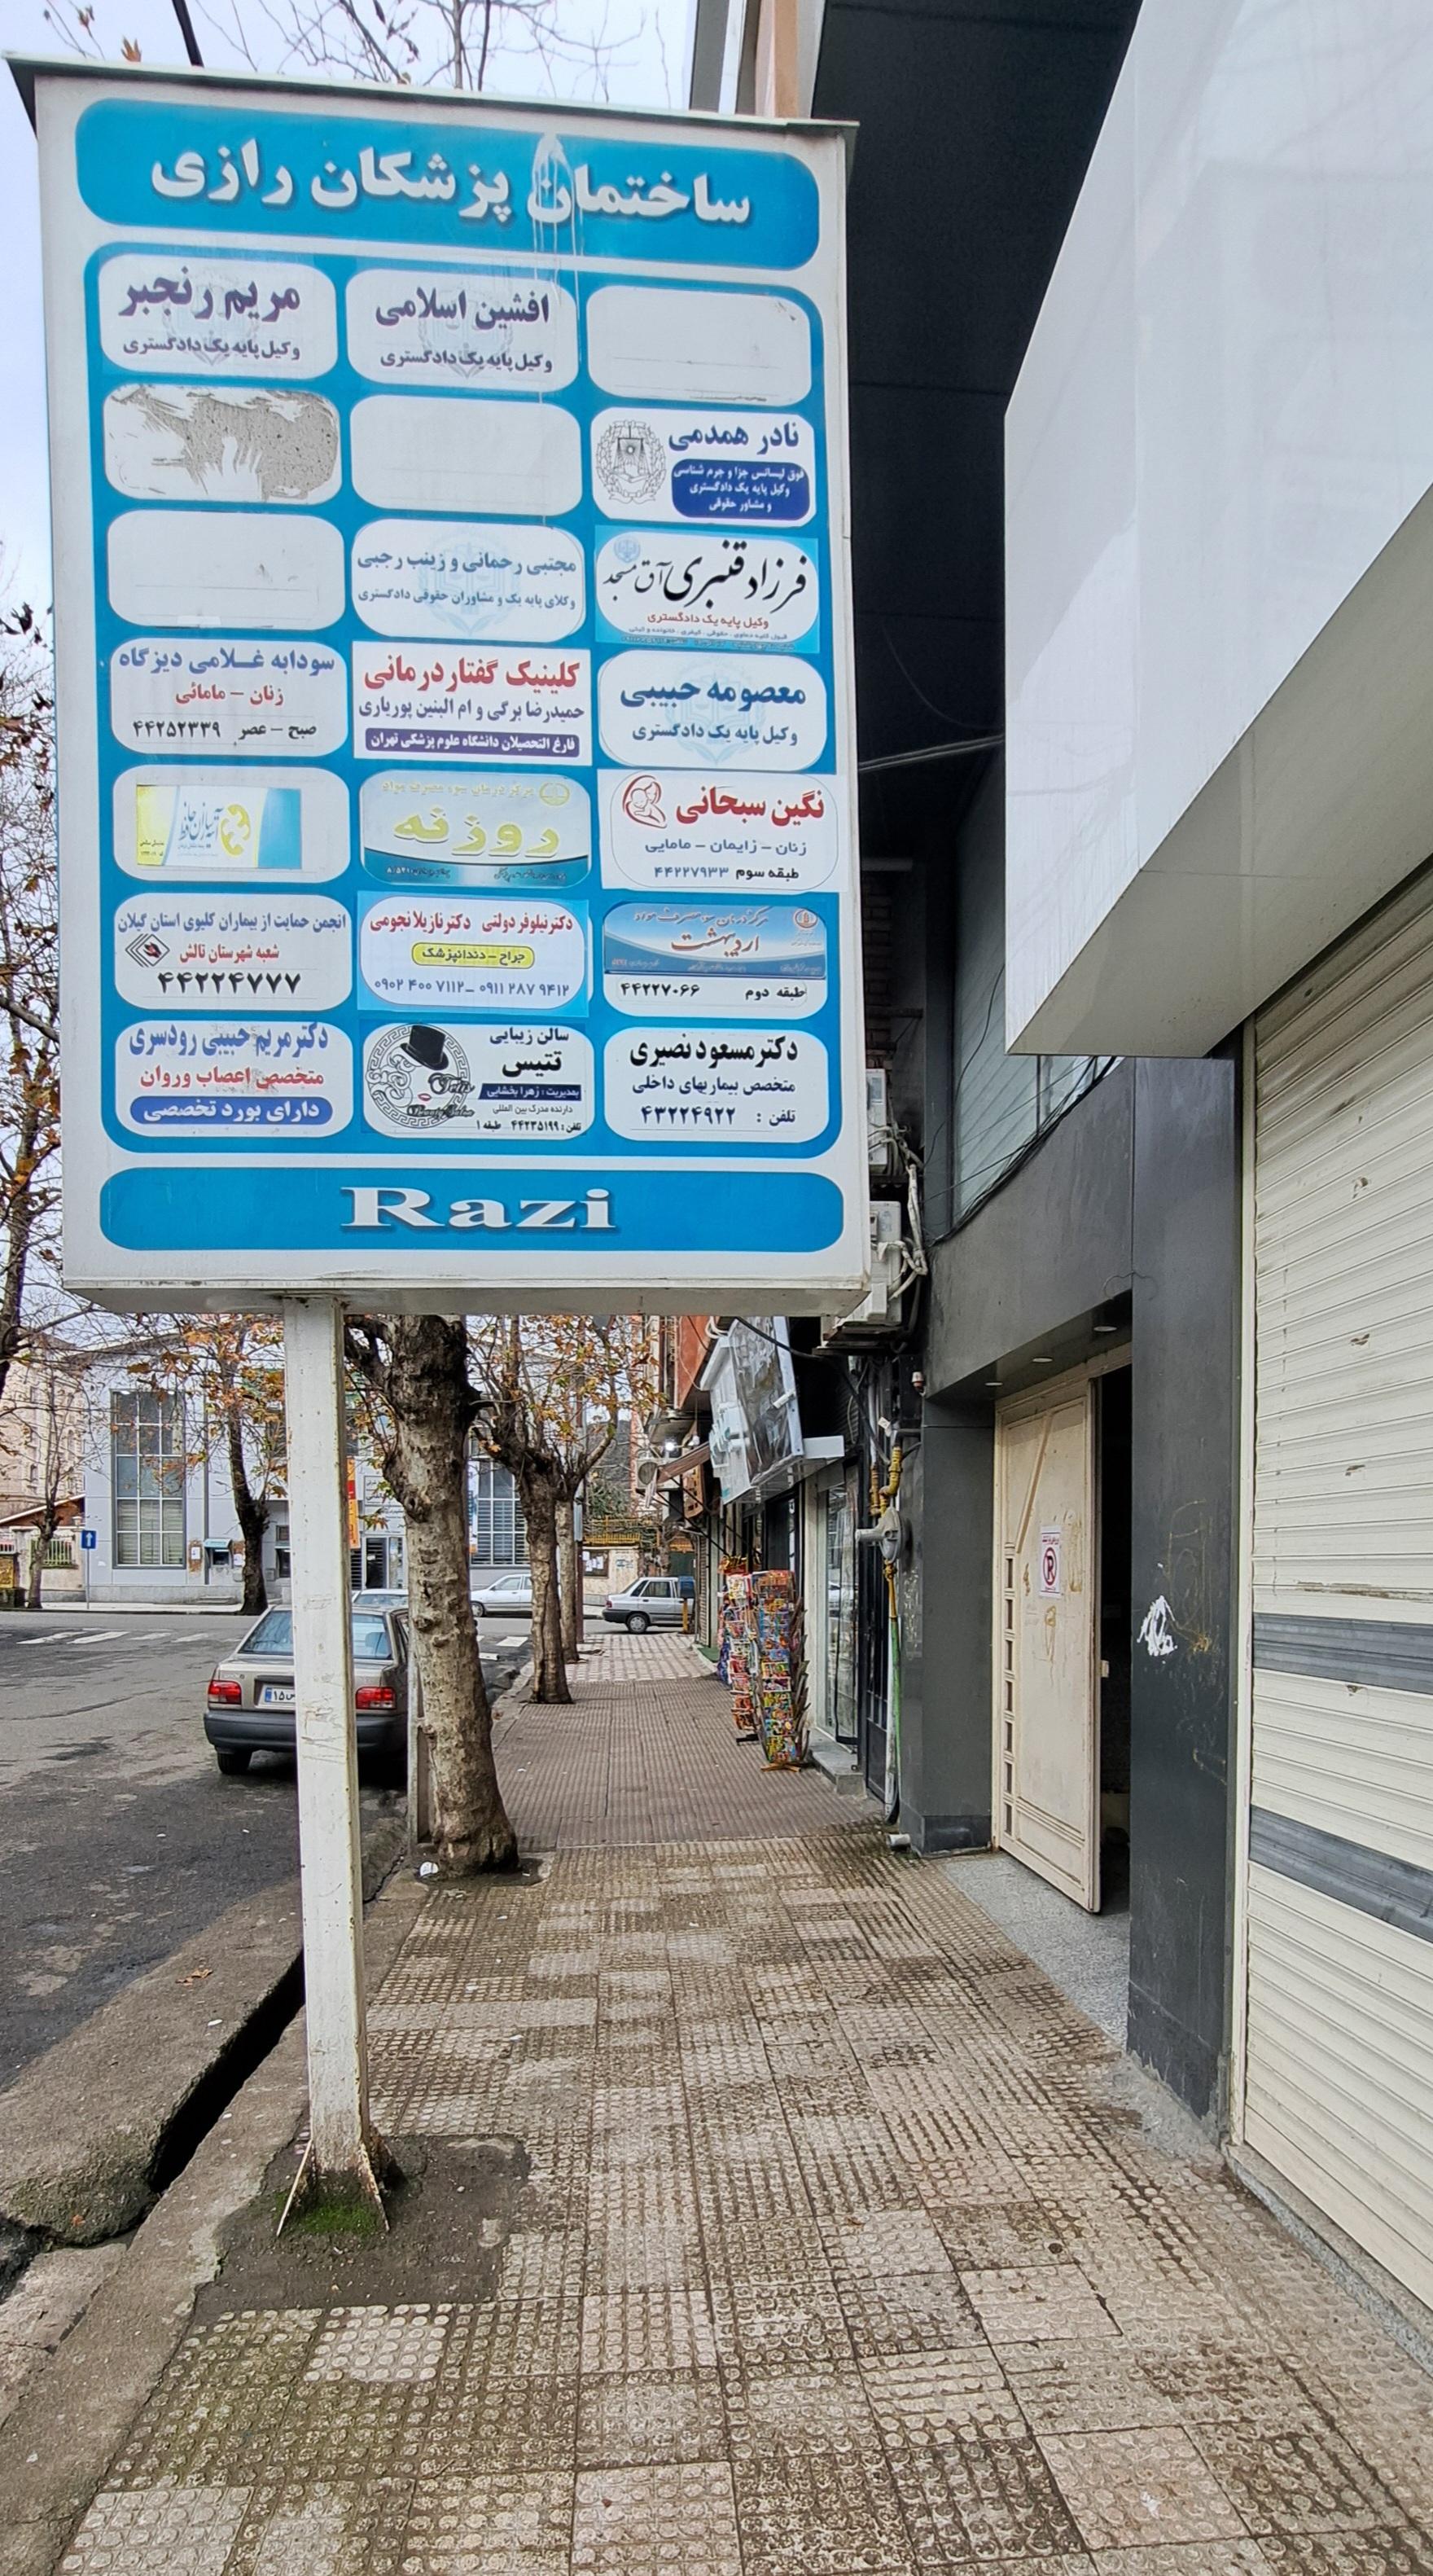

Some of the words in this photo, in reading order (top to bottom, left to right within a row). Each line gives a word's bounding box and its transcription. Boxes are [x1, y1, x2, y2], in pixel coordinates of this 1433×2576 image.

[151, 138, 295, 207] رازی
[311, 147, 511, 222] پزشکان
[528, 167, 751, 226] ساختمان
[119, 266, 213, 320] رنجبر
[226, 282, 300, 322] مریم
[376, 287, 466, 326] اسلامی
[475, 291, 549, 330] افشین
[124, 337, 201, 354] دادگستری
[204, 339, 230, 357] یک
[232, 340, 259, 359] پایه
[262, 340, 300, 360] وکیل
[380, 350, 457, 366] دادگستری
[459, 352, 484, 370] یک
[488, 353, 512, 372] پایه
[515, 353, 552, 372] وکیل
[668, 426, 748, 451] همدمی
[756, 422, 799, 454] نادر
[673, 465, 703, 477] شناسی
[707, 468, 725, 479] جرم
[728, 470, 732, 479] و
[734, 467, 748, 480] جزا
[787, 469, 804, 481] فوق
[690, 481, 732, 494] دادگستری
[734, 483, 749, 494] یک
[752, 483, 767, 495] پایه
[770, 483, 790, 497] وکیل
[709, 498, 736, 511] حقوقی
[740, 499, 765, 511] مشاور
[767, 503, 772, 512] و
[357, 551, 402, 570] رجبی
[407, 551, 445, 571] زینب
[452, 560, 458, 573] و
[462, 552, 522, 574] رحمانی
[526, 557, 576, 576] مجتبی
[664, 539, 747, 608] قنبری
[744, 555, 807, 613] فرزاد
[358, 588, 410, 602] دادگستری
[413, 591, 449, 603] حقوقی
[452, 591, 493, 605] مشاوران
[506, 595, 521, 607] یک
[525, 595, 542, 609] پایه
[545, 595, 576, 610] وکلای
[647, 612, 699, 624] دادگستری
[702, 614, 718, 626] یک
[721, 616, 741, 629] پایه
[743, 617, 769, 629] وکیل
[120, 647, 182, 674] دیزگاه
[189, 647, 265, 674] غلامی
[271, 650, 335, 676] سودابه
[506, 660, 580, 694] کلینیک
[250, 685, 283, 705] زنان
[620, 681, 700, 708] حبیبی
[707, 682, 806, 712] معصومه
[416, 697, 454, 719] البنین
[458, 700, 471, 719] ام
[476, 706, 483, 721] و
[488, 701, 522, 722] برگی
[526, 701, 585, 723] حمیدرضا
[239, 723, 266, 739] عصر
[288, 723, 316, 739] صبح
[370, 732, 398, 748] تهران
[633, 723, 704, 741] دادگستری
[708, 726, 730, 743] یک
[734, 726, 759, 745] پایه
[763, 726, 797, 745] وکیل
[401, 733, 436, 749] پزشکی
[438, 734, 460, 749] علوم
[462, 735, 499, 748] دانشگاه
[502, 736, 550, 752] التحصیلان
[552, 736, 575, 753] فارغ
[677, 786, 765, 824] سبحانی
[771, 790, 824, 827] نگین
[393, 807, 560, 858] روزنه
[645, 839, 691, 853] مامایی
[710, 839, 757, 853] زایمان
[776, 841, 807, 856] زنان
[654, 867, 729, 878] ۴۴۲۲۷۹۳۳
[735, 869, 765, 880] سوم
[768, 868, 799, 882] طبقه
[118, 912, 147, 932] گیلان
[150, 913, 180, 932] استان
[183, 912, 215, 931] کلیوی
[219, 912, 257, 932] بیماران
[261, 913, 270, 932] از
[274, 915, 309, 932] حمایت
[313, 915, 346, 933] انجمن
[445, 913, 471, 934] دکتر
[482, 913, 515, 933] دولتی
[518, 912, 549, 933] نیلوفر
[549, 915, 572, 934] دکتر
[179, 943, 205, 963] تالش
[208, 944, 252, 963] شهرستان
[256, 945, 279, 963] شعبه
[423, 948, 486, 963] دندانپزشک
[499, 953, 525, 965] جراح
[158, 972, 301, 994] ۴۴۲۲۴۷۷۷
[436, 980, 464, 993] ۷۱۱۲
[509, 983, 535, 994] ۲۸۷
[539, 984, 570, 996] ۹۴۱۲
[620, 983, 699, 997] ۴۴۲۲۷۰۶۶
[745, 987, 769, 1001] دوم
[776, 986, 805, 1001] طبقه
[130, 1025, 197, 1055] رودسری
[203, 1028, 250, 1056] حبیبی
[256, 1026, 291, 1057] مریم
[291, 1022, 328, 1057] دکتر
[489, 1027, 532, 1045] زیبایی
[537, 1028, 569, 1045] سالن
[630, 1033, 691, 1067] نصیری
[695, 1040, 754, 1069] مسعود
[756, 1036, 798, 1068] دکتر
[196, 1065, 251, 1087] اعصاب
[256, 1067, 324, 1089] متخصص
[633, 1074, 674, 1094] داخلی
[520, 1086, 539, 1098] زهرا
[679, 1076, 738, 1095] بیماریهای
[743, 1080, 795, 1095] متخصص
[143, 1099, 217, 1121] تخصصی
[221, 1104, 261, 1122] بورد
[266, 1100, 319, 1122] دارای
[493, 1104, 512, 1114] المللی
[528, 1105, 549, 1114] مدرک
[550, 1105, 572, 1115] دارنده
[641, 1106, 735, 1125] ۴۳۲۲۴۹۲۲
[769, 1109, 795, 1126] تلفن
[483, 1121, 501, 1132] طبقه
[511, 1120, 559, 1131] ۴۴۲۳۵۱۹۹
[566, 1122, 581, 1133] تلفن
[340, 1187, 616, 1229] Razi
